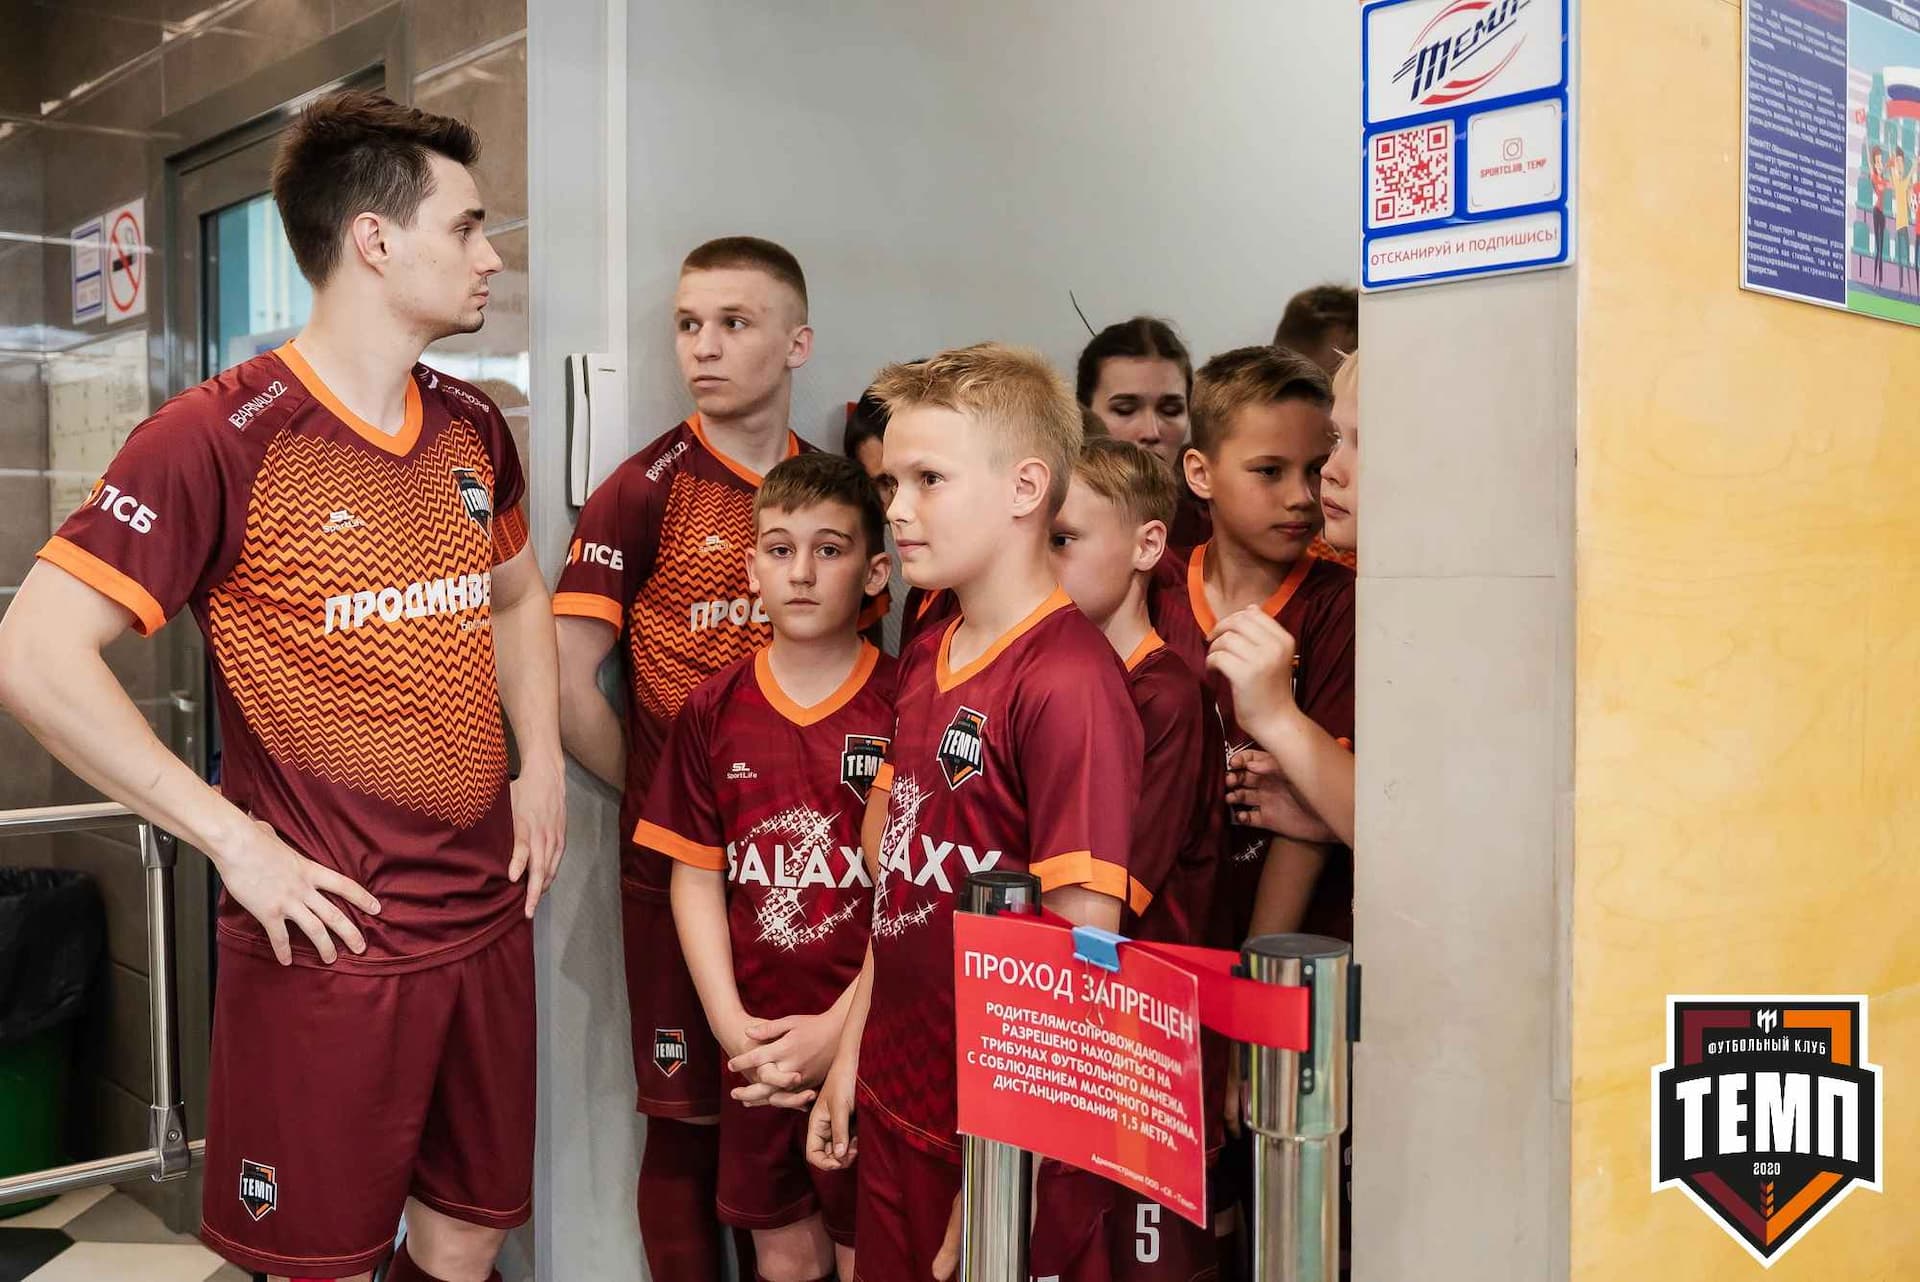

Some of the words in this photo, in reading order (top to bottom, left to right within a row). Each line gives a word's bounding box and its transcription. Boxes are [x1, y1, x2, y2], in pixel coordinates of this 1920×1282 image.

[1370, 240, 1451, 266] ОТСКАНИРУЙ
[1455, 242, 1465, 254] И
[1468, 227, 1558, 251] ПОДПИШИСЬ!
[92, 484, 158, 534] ПСБ
[582, 542, 624, 571] ПСБ
[943, 728, 981, 766] ТЕМП
[964, 949, 1075, 1005] ПРОХОД
[1080, 973, 1194, 1046] ЗАПРЕЩЕН
[985, 1001, 1183, 1077] РОДИТЕЛЯМ/СОПРОВОЖДАЮЩИМ
[1001, 1022, 1078, 1053] РАЗРЕШЕНО
[1080, 1041, 1156, 1082] НАХОДИТЬСЯ
[1156, 1070, 1172, 1090] НА
[966, 1050, 977, 1065] С
[978, 1052, 1078, 1090] СОБЛЮДЕНИЕМ
[1080, 1079, 1150, 1117] МАСОЧНОГО
[1150, 1106, 1198, 1145] РЕЖИМА,
[980, 1035, 1048, 1064] ТРИБУНАХ
[1050, 1051, 1138, 1092] ФУТБОЛЬНОГО
[1140, 1082, 1188, 1120] МАНЕЖА,
[992, 1073, 1119, 1123] ДИСТАНЦИРОВАНИЯ
[1120, 1112, 1139, 1131] 1,5
[1140, 1120, 1178, 1152] МЕТРА.
[242, 1177, 274, 1204] ТЕМП
[1135, 1203, 1161, 1264] 5
